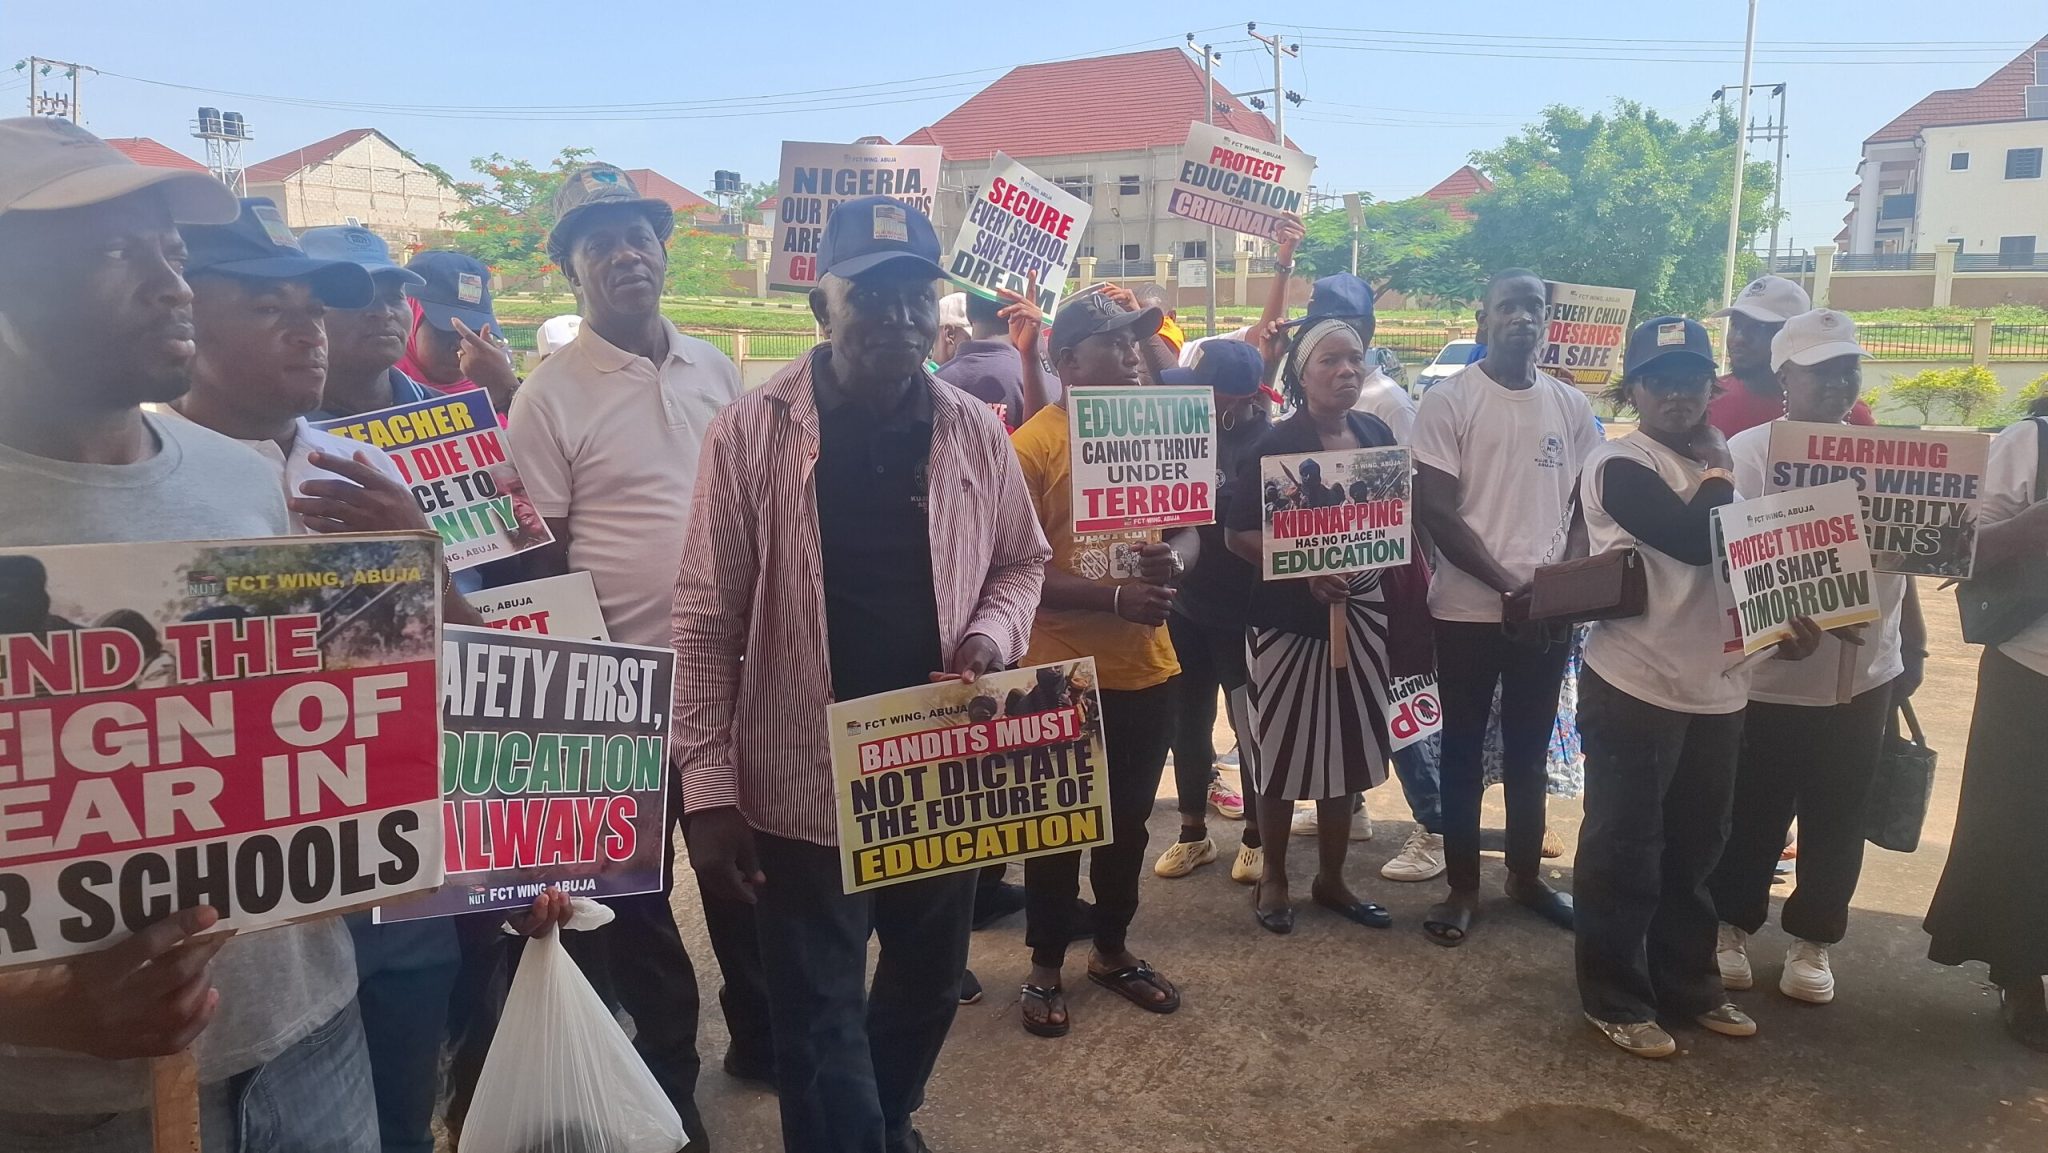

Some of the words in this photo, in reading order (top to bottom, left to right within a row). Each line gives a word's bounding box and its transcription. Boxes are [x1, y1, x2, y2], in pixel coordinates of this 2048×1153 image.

[793, 167, 927, 196] NIGERIA,
[1209, 146, 1286, 183] PROTECT
[1179, 160, 1302, 213] EDUCATION
[781, 196, 822, 224] OUR
[988, 177, 1074, 240] SECURE
[783, 227, 822, 253] ARE
[970, 198, 1015, 238] EVERY
[1009, 219, 1068, 270] SCHOOL,
[971, 229, 1006, 265] SAVE
[1003, 244, 1053, 285] EVERY
[950, 249, 1056, 315] DREAM
[1553, 303, 1595, 323] EVERY
[1594, 307, 1627, 325] CHILD
[1548, 321, 1622, 347] DESERVES
[1543, 344, 1560, 364] A
[1565, 345, 1611, 367] SAFE
[1076, 397, 1210, 438] EDUCATION
[411, 440, 469, 481] DIE
[466, 431, 506, 468] IN
[1082, 439, 1151, 465] CANNOT
[1154, 437, 1209, 461] THRIVE
[1807, 435, 1949, 469] LEARNING
[452, 470, 497, 502] TO
[1107, 463, 1189, 484] UNDER
[1875, 468, 1979, 499] WHERE
[1082, 482, 1209, 518] TERROR
[1163, 514, 1180, 522] ABUJA
[1754, 515, 1764, 524] FCT
[1765, 511, 1786, 521] WING,
[1788, 505, 1815, 516] ABUJA
[1273, 498, 1404, 540] KIDNAPPING
[466, 543, 499, 558] ABUJA
[1272, 538, 1405, 576] EDUCATION
[1295, 538, 1318, 549] HAS
[1322, 535, 1337, 545] NO
[1341, 531, 1373, 544] PLACE
[1375, 529, 1386, 539] IN
[1729, 528, 1783, 570] PROTECT
[1786, 514, 1859, 552] THOSE
[226, 575, 272, 592] FCT
[278, 571, 345, 589] WING,
[352, 567, 422, 585] ABUJA
[1744, 562, 1775, 596] WHO
[1775, 547, 1842, 586] SHAPE
[497, 597, 533, 610] ABUJA
[1740, 570, 1870, 637] TOMORROW
[0, 627, 144, 700] ND
[165, 612, 322, 685] THE
[272, 672, 409, 747] OF
[564, 652, 662, 730] FIRST,
[865, 718, 886, 730] FCT
[889, 711, 926, 725] WING,
[929, 704, 968, 718] ABUJA
[860, 724, 989, 773] BANDITS
[995, 709, 1075, 748] MUST
[262, 744, 368, 821] IN
[850, 766, 927, 815] NOT
[938, 741, 1095, 796] DICTATE
[856, 804, 919, 845] THE
[927, 782, 1048, 830] FUTURE
[1056, 775, 1094, 807] OF
[860, 811, 1098, 882] EDUCATION
[58, 809, 419, 944] SCHOOLS
[468, 893, 485, 905] NUT
[490, 886, 514, 902] FCT
[554, 878, 596, 893] ABUJA
